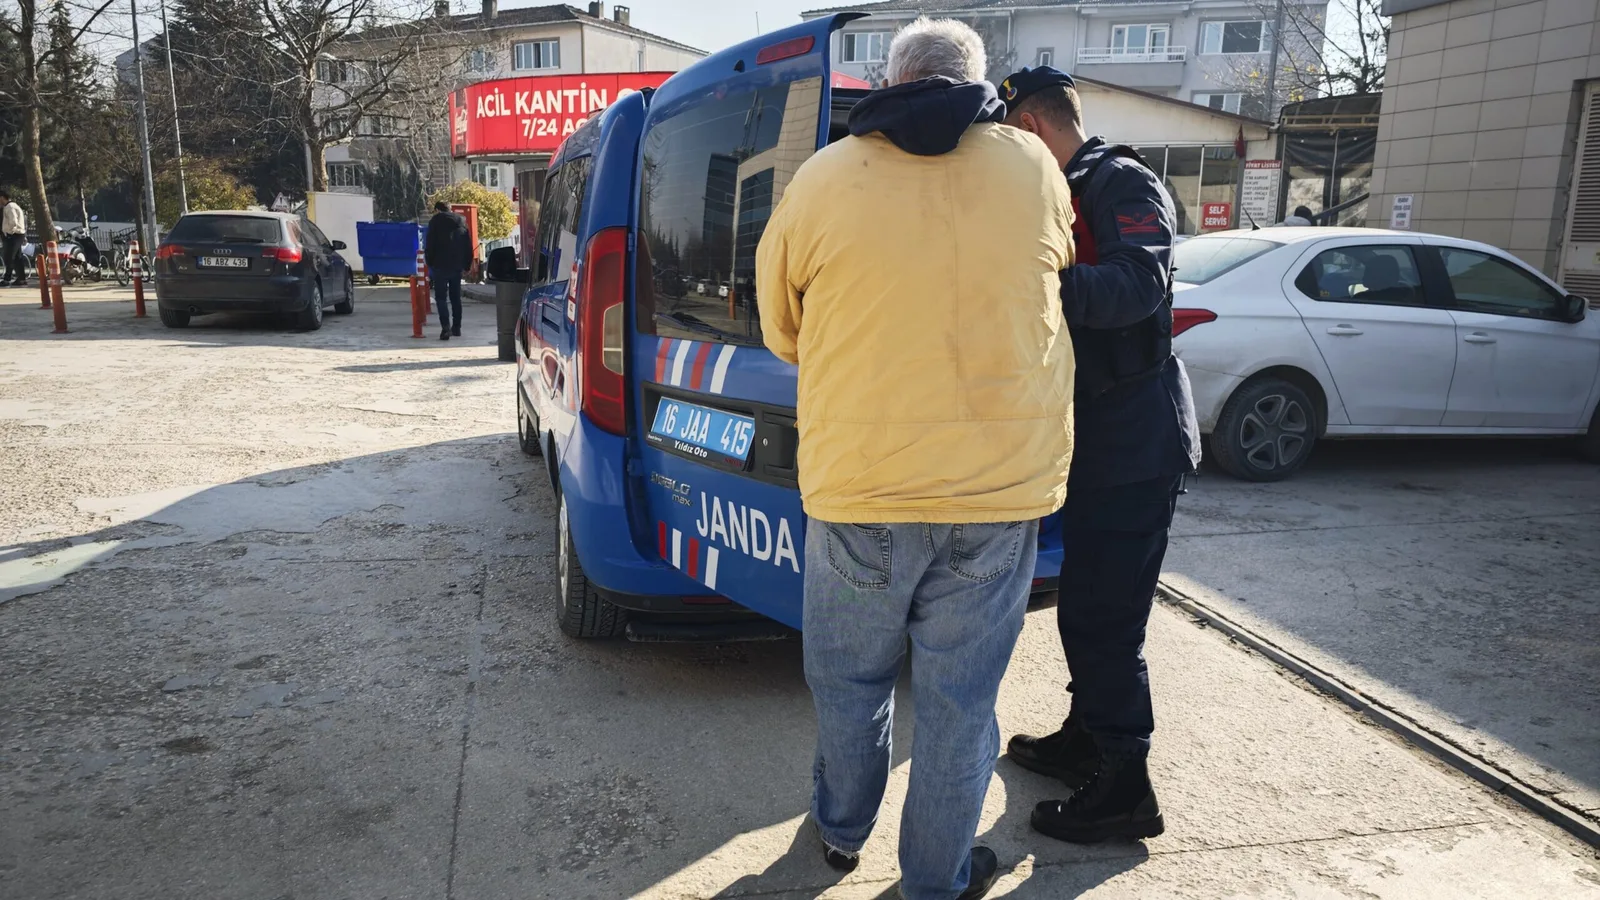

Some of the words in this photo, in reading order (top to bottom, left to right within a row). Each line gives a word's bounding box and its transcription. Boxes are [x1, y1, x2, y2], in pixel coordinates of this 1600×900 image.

[476, 87, 511, 119] ACİL
[515, 82, 607, 115] KANTİN
[522, 118, 558, 139] 7/24
[1209, 205, 1225, 214] SELF
[1204, 216, 1228, 226] SERVİS
[203, 257, 212, 266] 16
[215, 258, 231, 266] ABZ
[661, 403, 679, 434] 16
[680, 409, 711, 444] JAA
[720, 418, 753, 455] 415
[693, 447, 708, 458] Oto
[672, 493, 692, 507] max
[696, 491, 800, 573] JANDA
